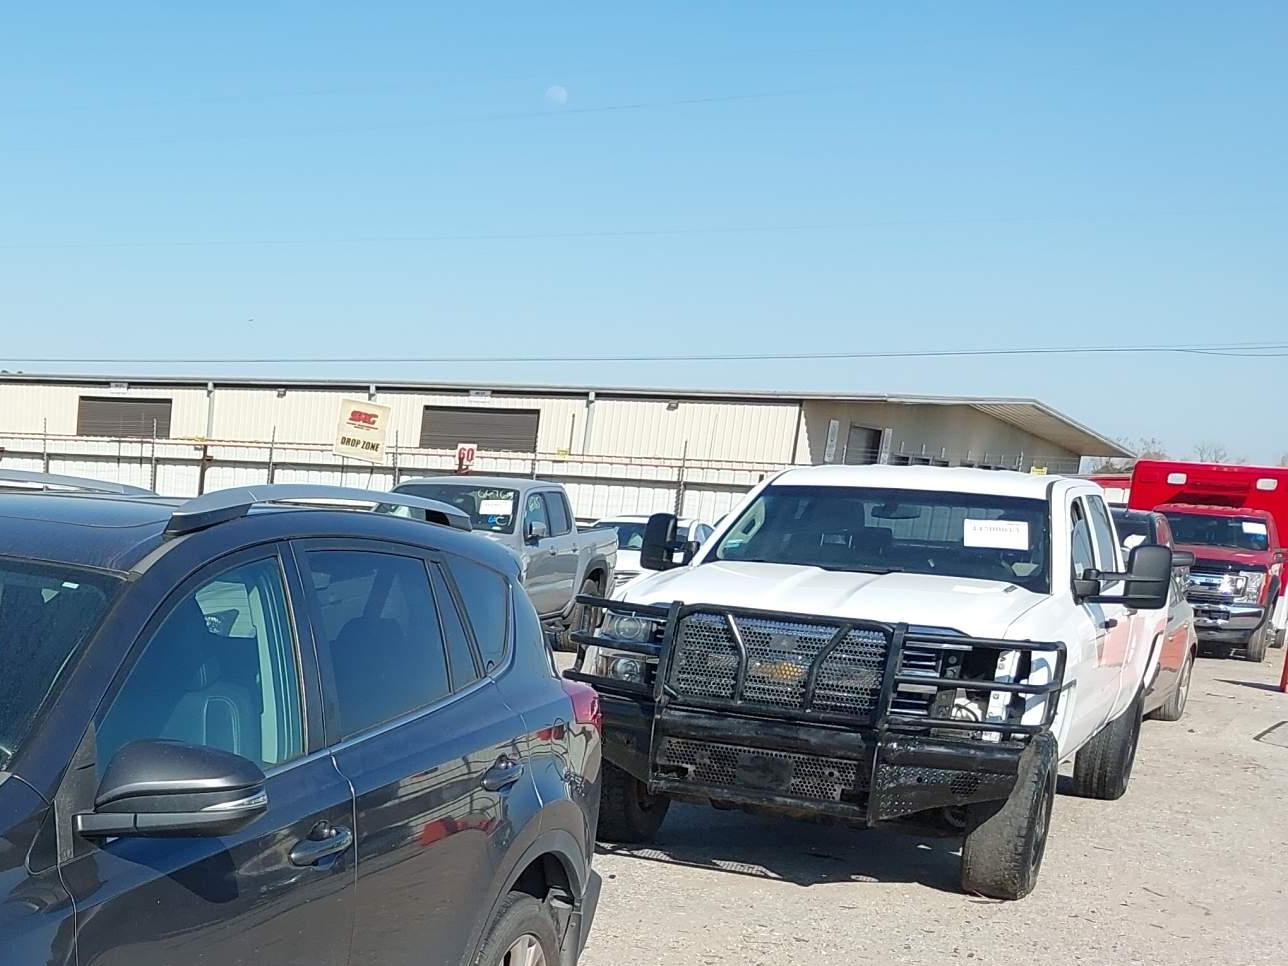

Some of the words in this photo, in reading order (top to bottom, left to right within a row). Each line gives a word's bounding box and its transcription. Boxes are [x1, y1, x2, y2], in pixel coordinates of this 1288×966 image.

[341, 436, 361, 448] DROP
[361, 440, 380, 452] ZONE
[458, 447, 475, 462] 60
